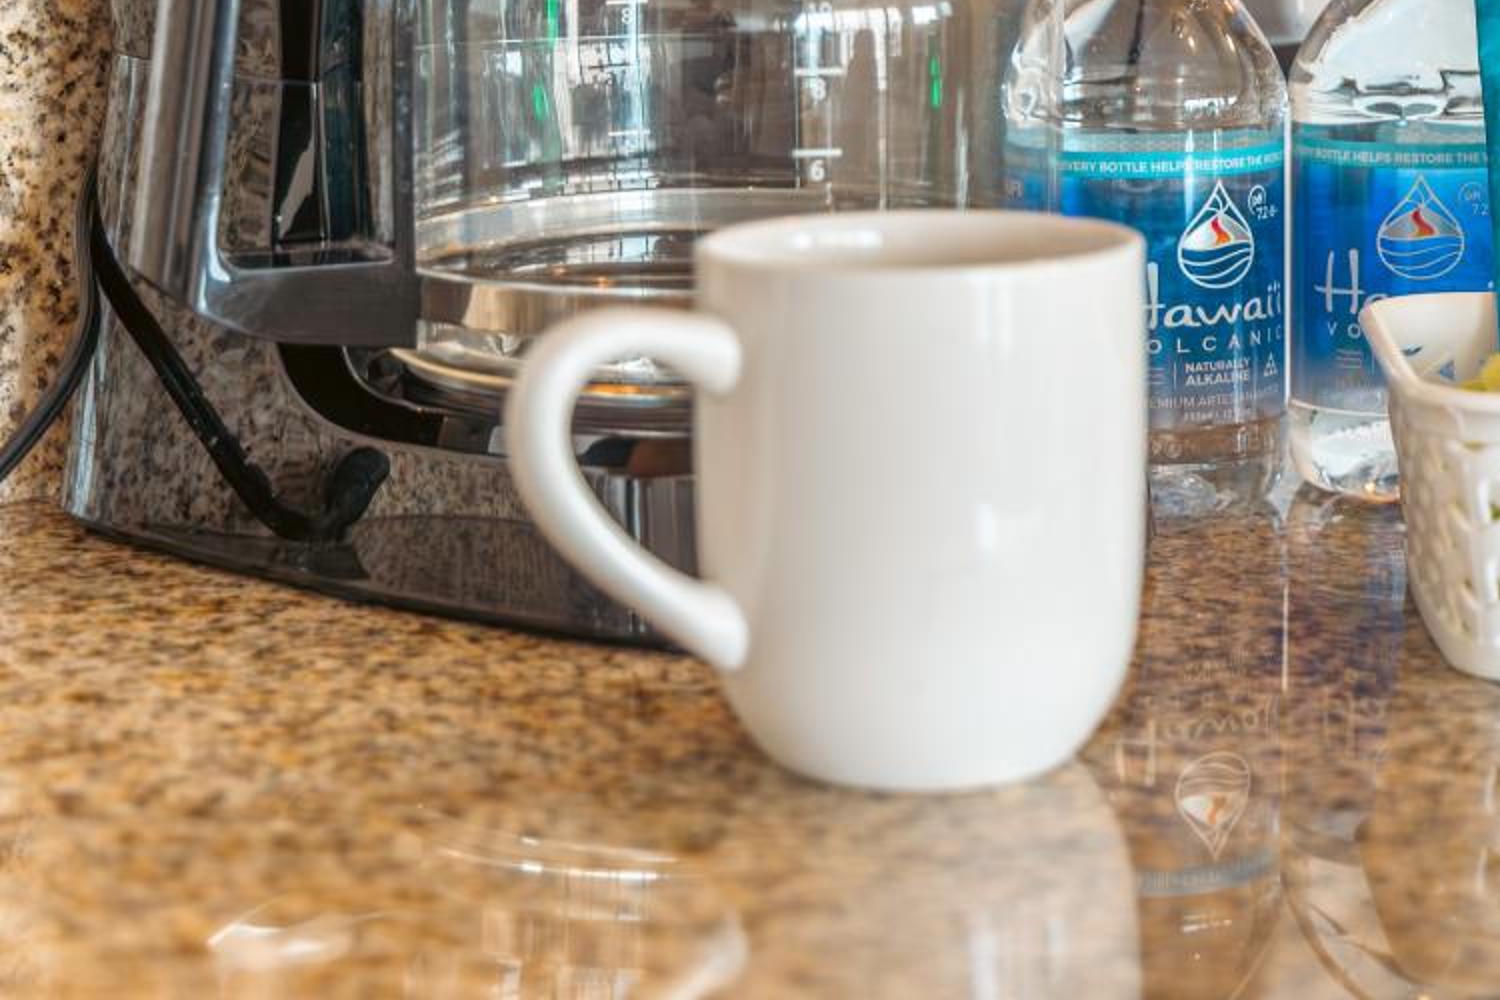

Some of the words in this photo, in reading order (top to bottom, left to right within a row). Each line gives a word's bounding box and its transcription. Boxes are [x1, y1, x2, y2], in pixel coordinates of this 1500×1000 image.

[810, 160, 826, 182] 6
[1100, 160, 1148, 173] BOTTLE
[1147, 325, 1282, 354] OLCANIC
